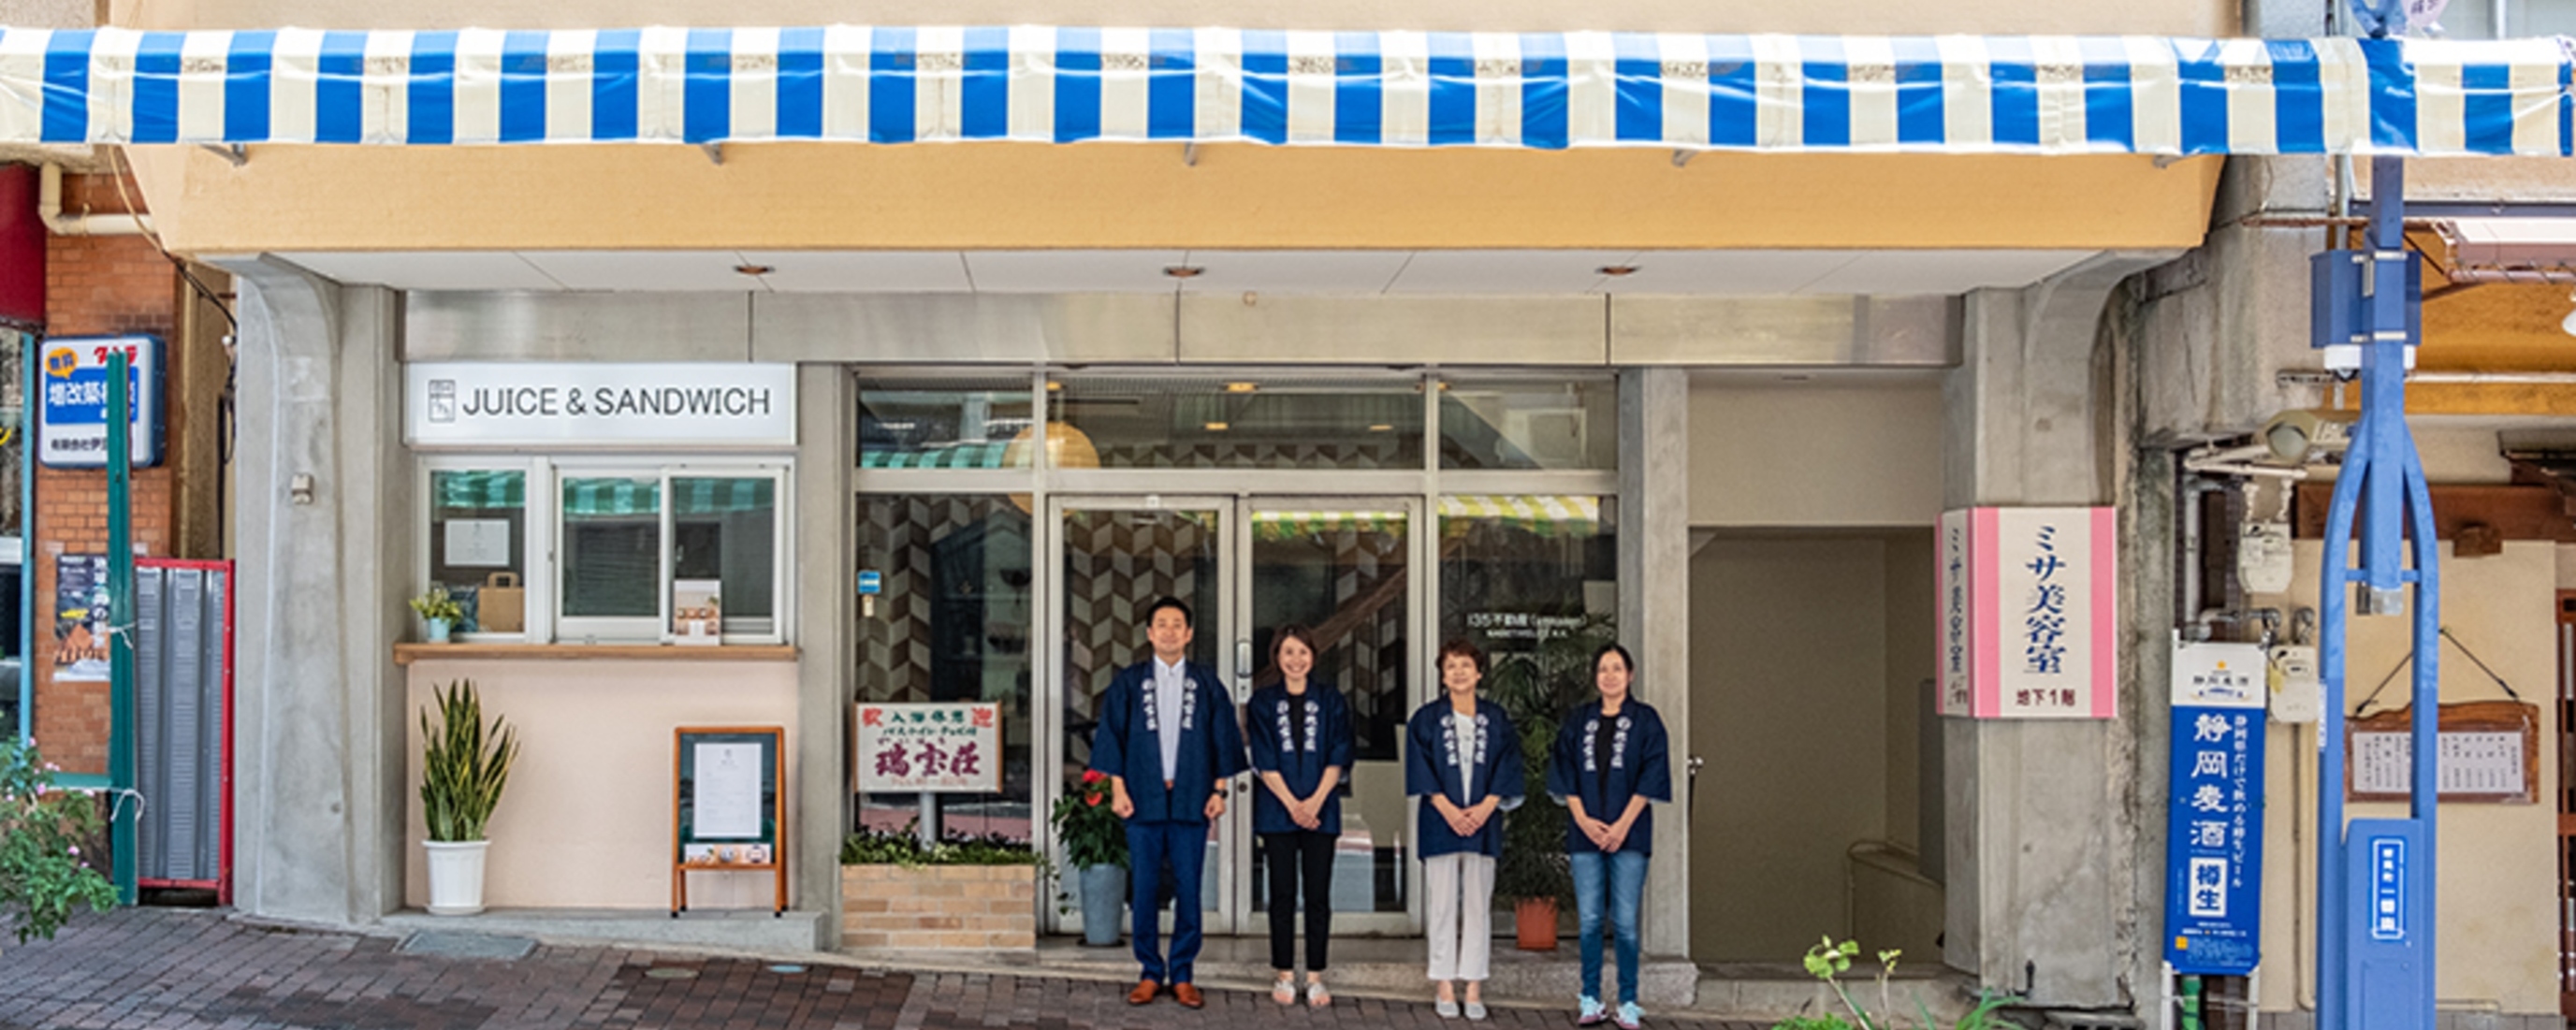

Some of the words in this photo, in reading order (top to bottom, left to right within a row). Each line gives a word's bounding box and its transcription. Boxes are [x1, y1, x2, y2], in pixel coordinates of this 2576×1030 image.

[462, 387, 559, 416] JUICE
[565, 388, 588, 416] &
[594, 387, 771, 416] SANDWICH
[2023, 525, 2067, 674] ミサ美容室
[2016, 689, 2075, 706] 地下1階
[875, 741, 980, 777] 瑞宝荘
[2190, 714, 2232, 847] 静岡麦酒
[2196, 863, 2221, 910] 樽生
